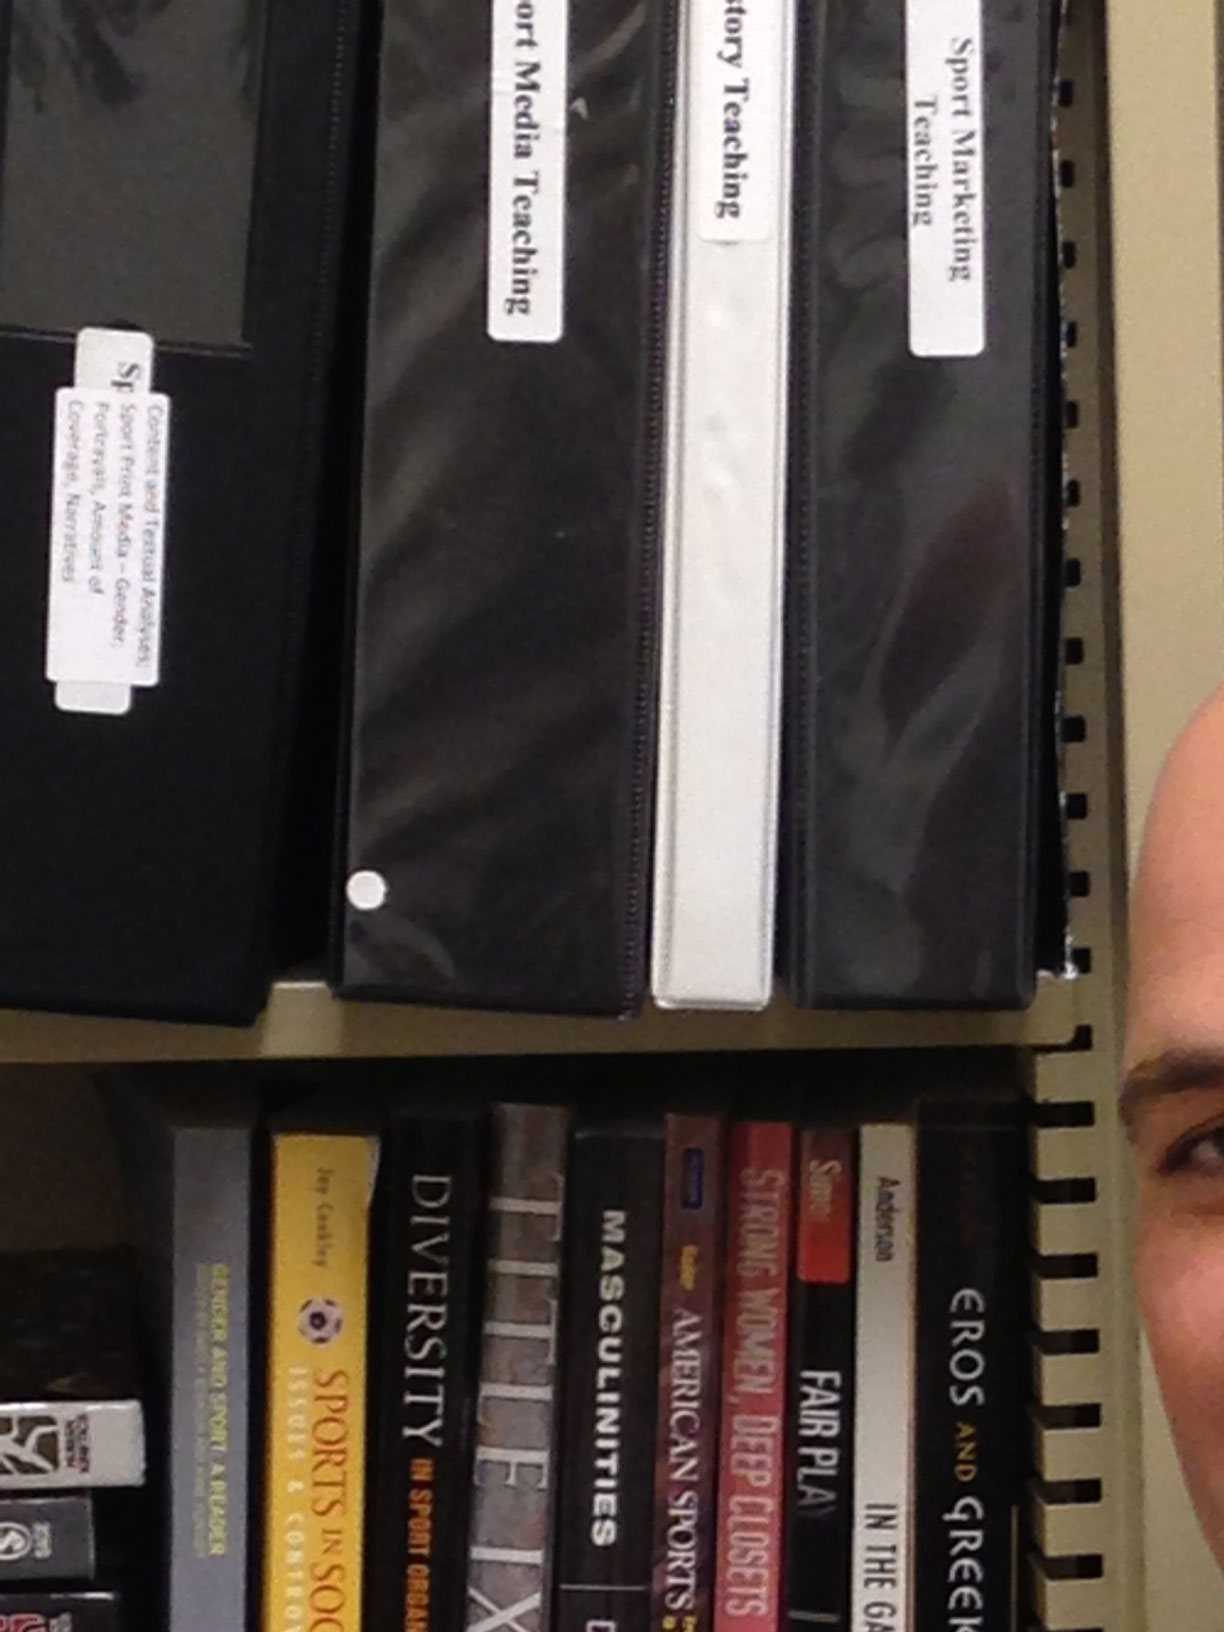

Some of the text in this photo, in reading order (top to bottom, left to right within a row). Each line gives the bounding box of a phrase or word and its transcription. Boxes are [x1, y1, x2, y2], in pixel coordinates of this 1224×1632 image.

[514, 62, 542, 159] Media
[717, 77, 750, 219] Teaching
[911, 95, 939, 227] Teaching
[945, 38, 978, 282] Sport Marketing
[507, 171, 539, 316] Teaching
[117, 403, 137, 450] Sport
[145, 404, 164, 475] Content
[117, 455, 135, 498] Print
[143, 481, 160, 513] and
[62, 494, 81, 583] Narratives
[115, 503, 133, 558] Media
[141, 519, 158, 583] Textual
[87, 576, 105, 595] of
[739, 1168, 784, 1276] STRONG
[874, 1177, 901, 1262] Anderson
[403, 1173, 451, 1448] DIVERSITY
[475, 1173, 564, 1489] TITLE
[948, 1287, 986, 1407] EROS
[287, 1366, 308, 1462] ISSUES
[590, 1208, 627, 1547] MASCULINITIES
[796, 1370, 843, 1439] FAIR
[310, 1369, 349, 1517] SPORTS
[413, 1458, 434, 1480] IN
[664, 1307, 703, 1610] AMERICAN SPORTS
[728, 1414, 775, 1486] DEEP
[953, 1421, 978, 1484] AND
[321, 1528, 342, 1556] IN
[407, 1488, 433, 1557] SPORT
[725, 1495, 769, 1616] CLOSETS
[862, 1503, 896, 1530] IN
[862, 1544, 896, 1588] THE
